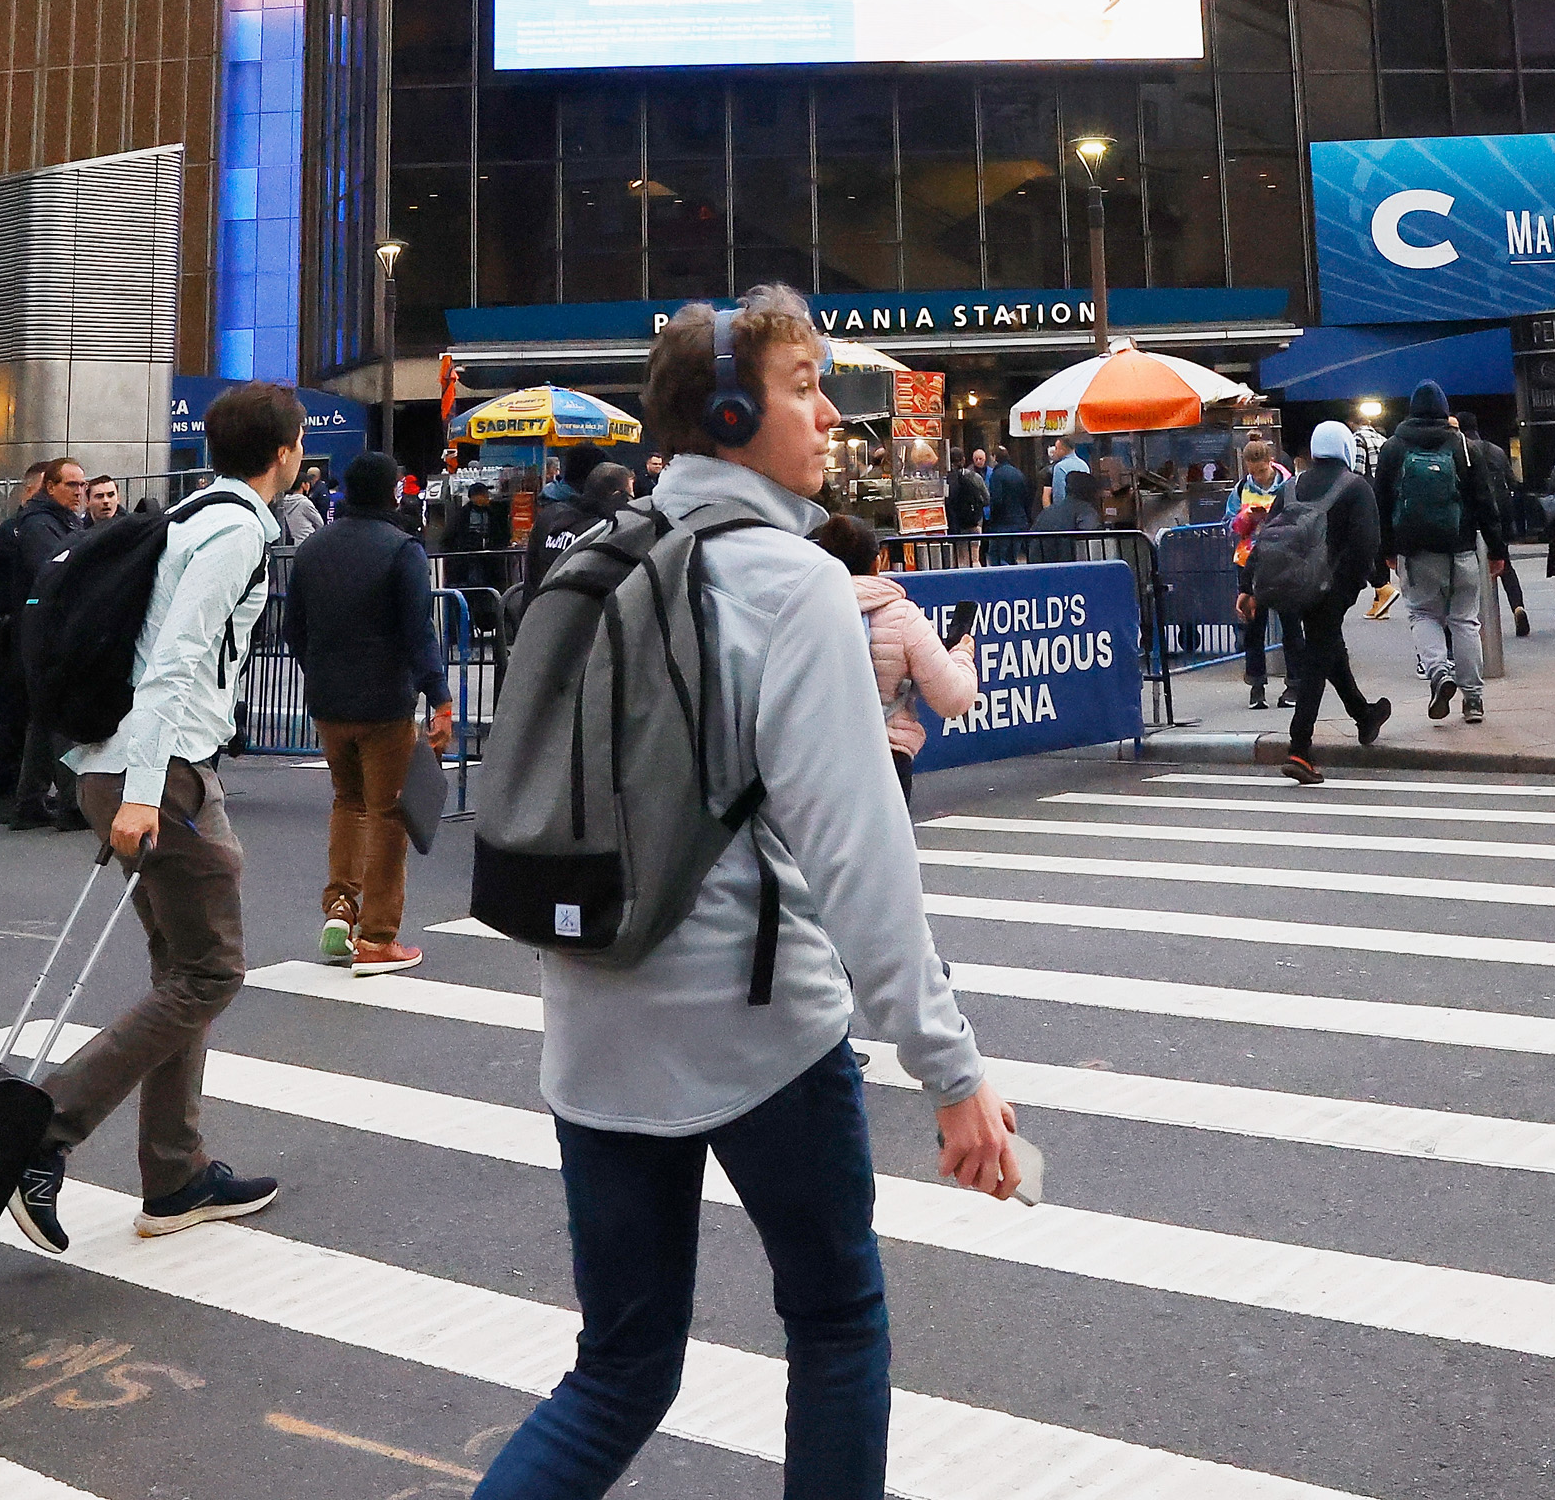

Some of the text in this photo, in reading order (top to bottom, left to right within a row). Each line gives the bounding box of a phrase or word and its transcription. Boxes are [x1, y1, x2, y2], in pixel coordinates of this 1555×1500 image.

[1370, 188, 1461, 270] C
[653, 301, 1096, 335] PVANIA STATION
[980, 630, 1114, 683] FAMOUS
[941, 683, 1058, 737] ARENA
